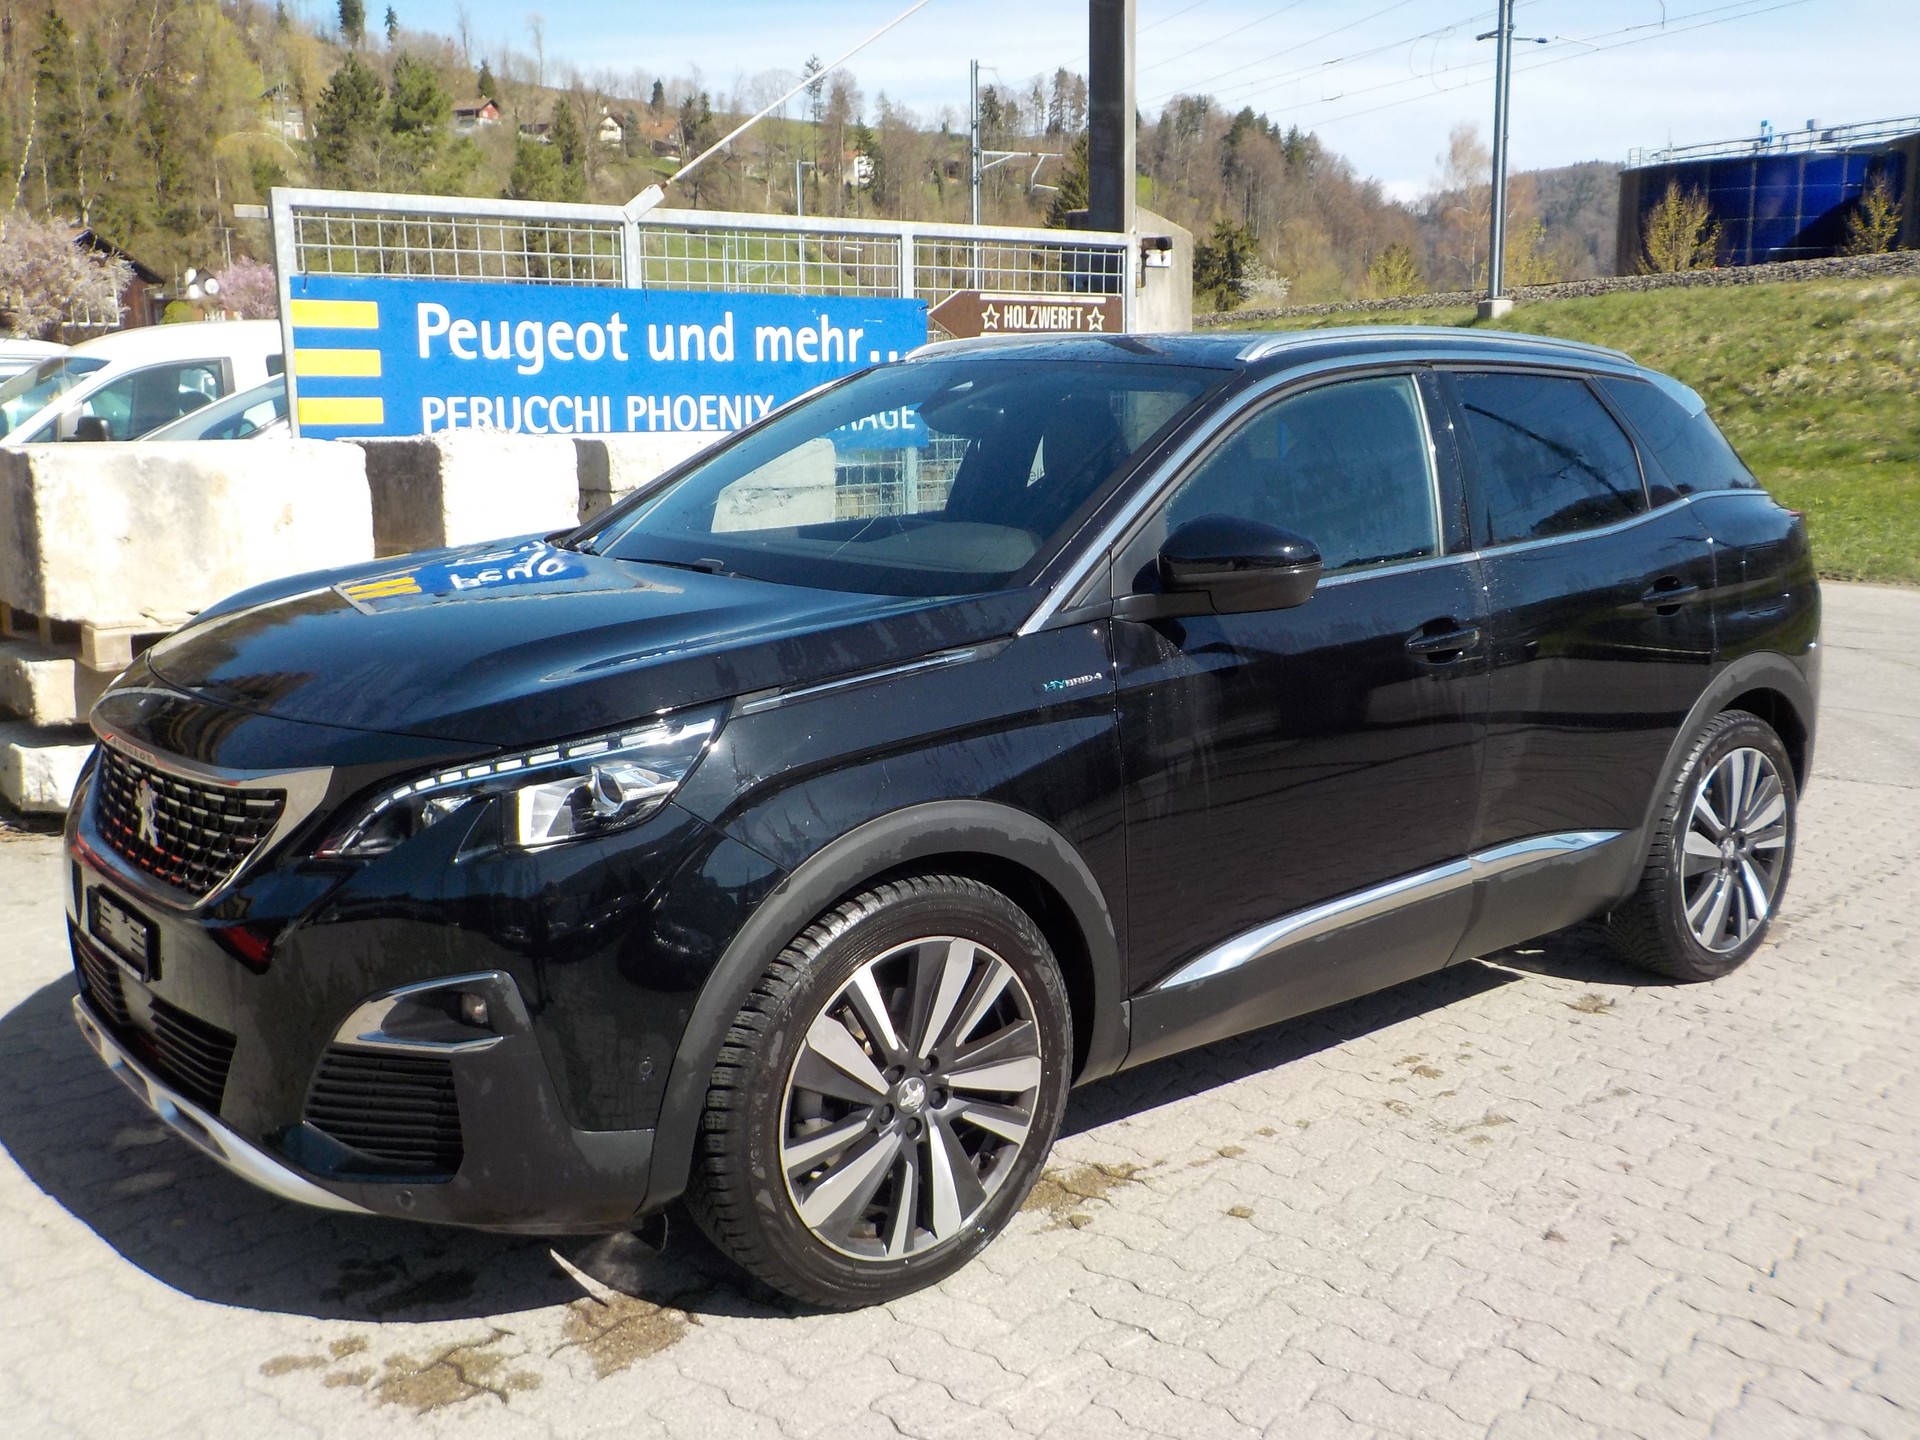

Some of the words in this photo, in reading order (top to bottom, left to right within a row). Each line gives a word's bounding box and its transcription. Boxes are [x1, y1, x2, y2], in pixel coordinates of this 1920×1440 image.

[1003, 304, 1084, 330] HOLZWERFT
[417, 302, 629, 375] Peugeot
[648, 311, 734, 362] und
[755, 313, 909, 363] mehr..
[421, 395, 611, 434] PERUCCHI
[626, 394, 774, 432] PHOENIX
